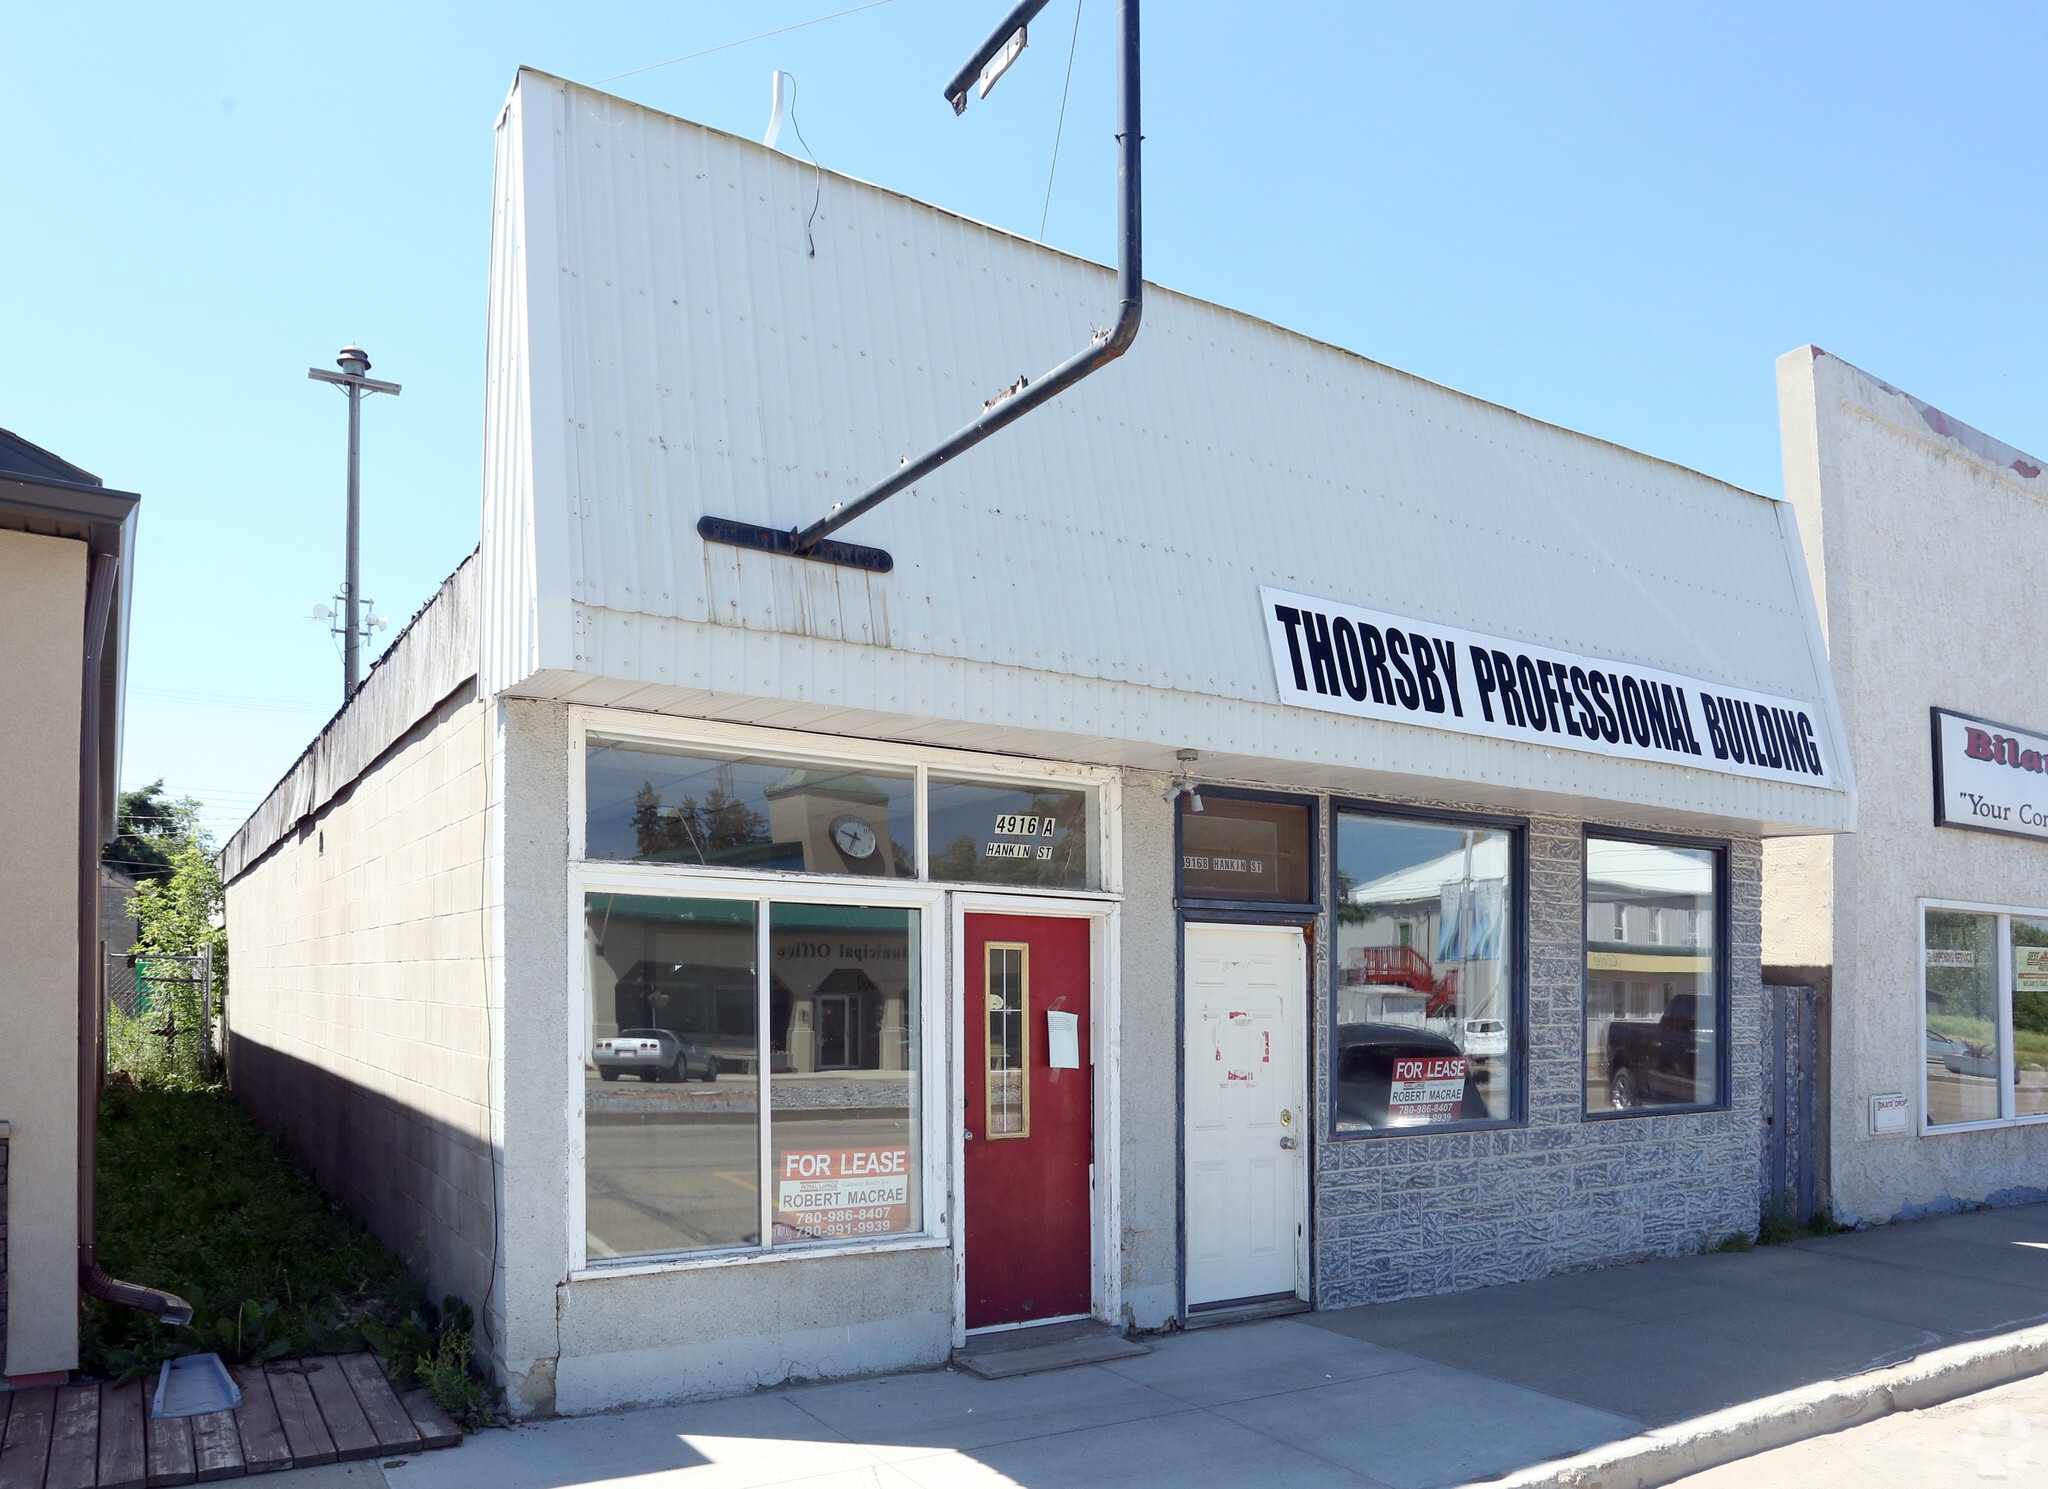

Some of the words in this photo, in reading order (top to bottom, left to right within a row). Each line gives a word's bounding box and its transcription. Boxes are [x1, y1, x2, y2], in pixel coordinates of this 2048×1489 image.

[1275, 604, 1464, 718] THORSBY
[1469, 645, 1702, 756] PROFESSIONAL
[1699, 693, 1824, 776] BUILDING
[996, 816, 1037, 834] 4916
[1043, 819, 1053, 836] A
[987, 844, 1031, 857] HANKIN
[1037, 846, 1052, 859] ST
[1213, 859, 1246, 871] HANKIN
[1251, 861, 1262, 872] ST
[1397, 1062, 1422, 1079] FOR
[1428, 1061, 1465, 1077] LEASE
[1393, 1091, 1426, 1102] ROBERT
[1430, 1089, 1461, 1100] MACRAE
[1399, 1103, 1454, 1115] 780-986-8407
[786, 1154, 831, 1177] FOR
[840, 1150, 906, 1175] LEASE
[783, 1191, 841, 1209] ROBERT
[847, 1187, 904, 1205] MACRAE
[795, 1207, 891, 1225] 780-986-8407
[795, 1219, 891, 1238] 780-991-9939
